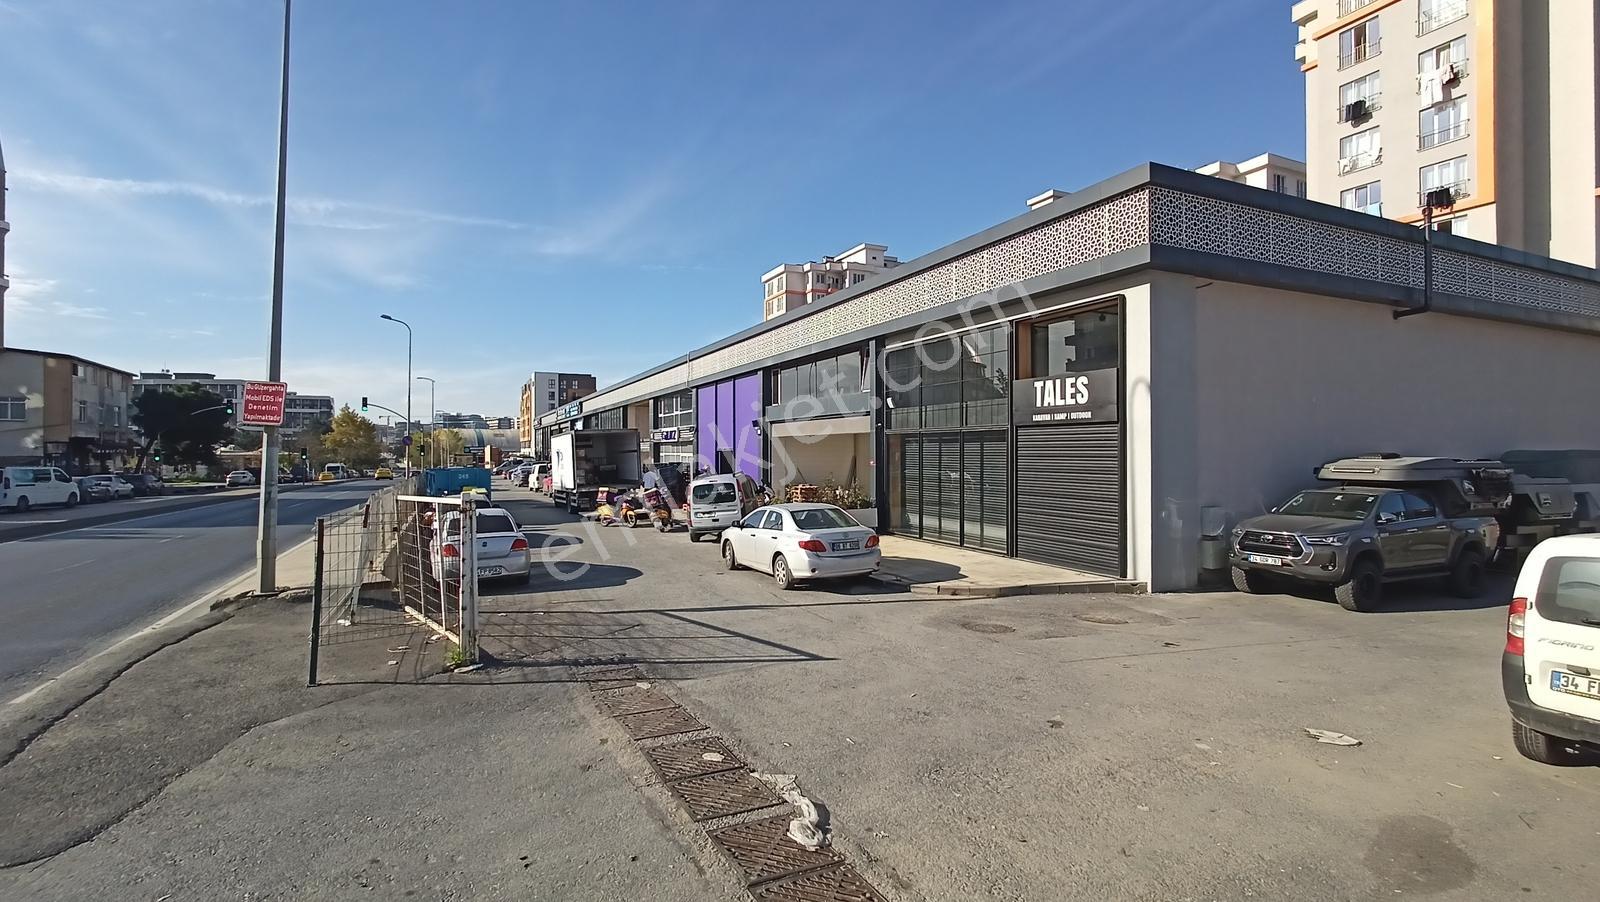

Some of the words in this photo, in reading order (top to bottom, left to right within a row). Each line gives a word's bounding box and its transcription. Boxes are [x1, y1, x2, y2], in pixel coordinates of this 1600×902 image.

[1033, 376, 1089, 407] TALES
[248, 403, 278, 411] Denetim
[1054, 412, 1067, 420] KAMP
[1070, 411, 1092, 420] OUTDOOR
[1538, 637, 1594, 651] FIORINO
[1561, 675, 1579, 690] 34
[1587, 680, 1600, 695] F
